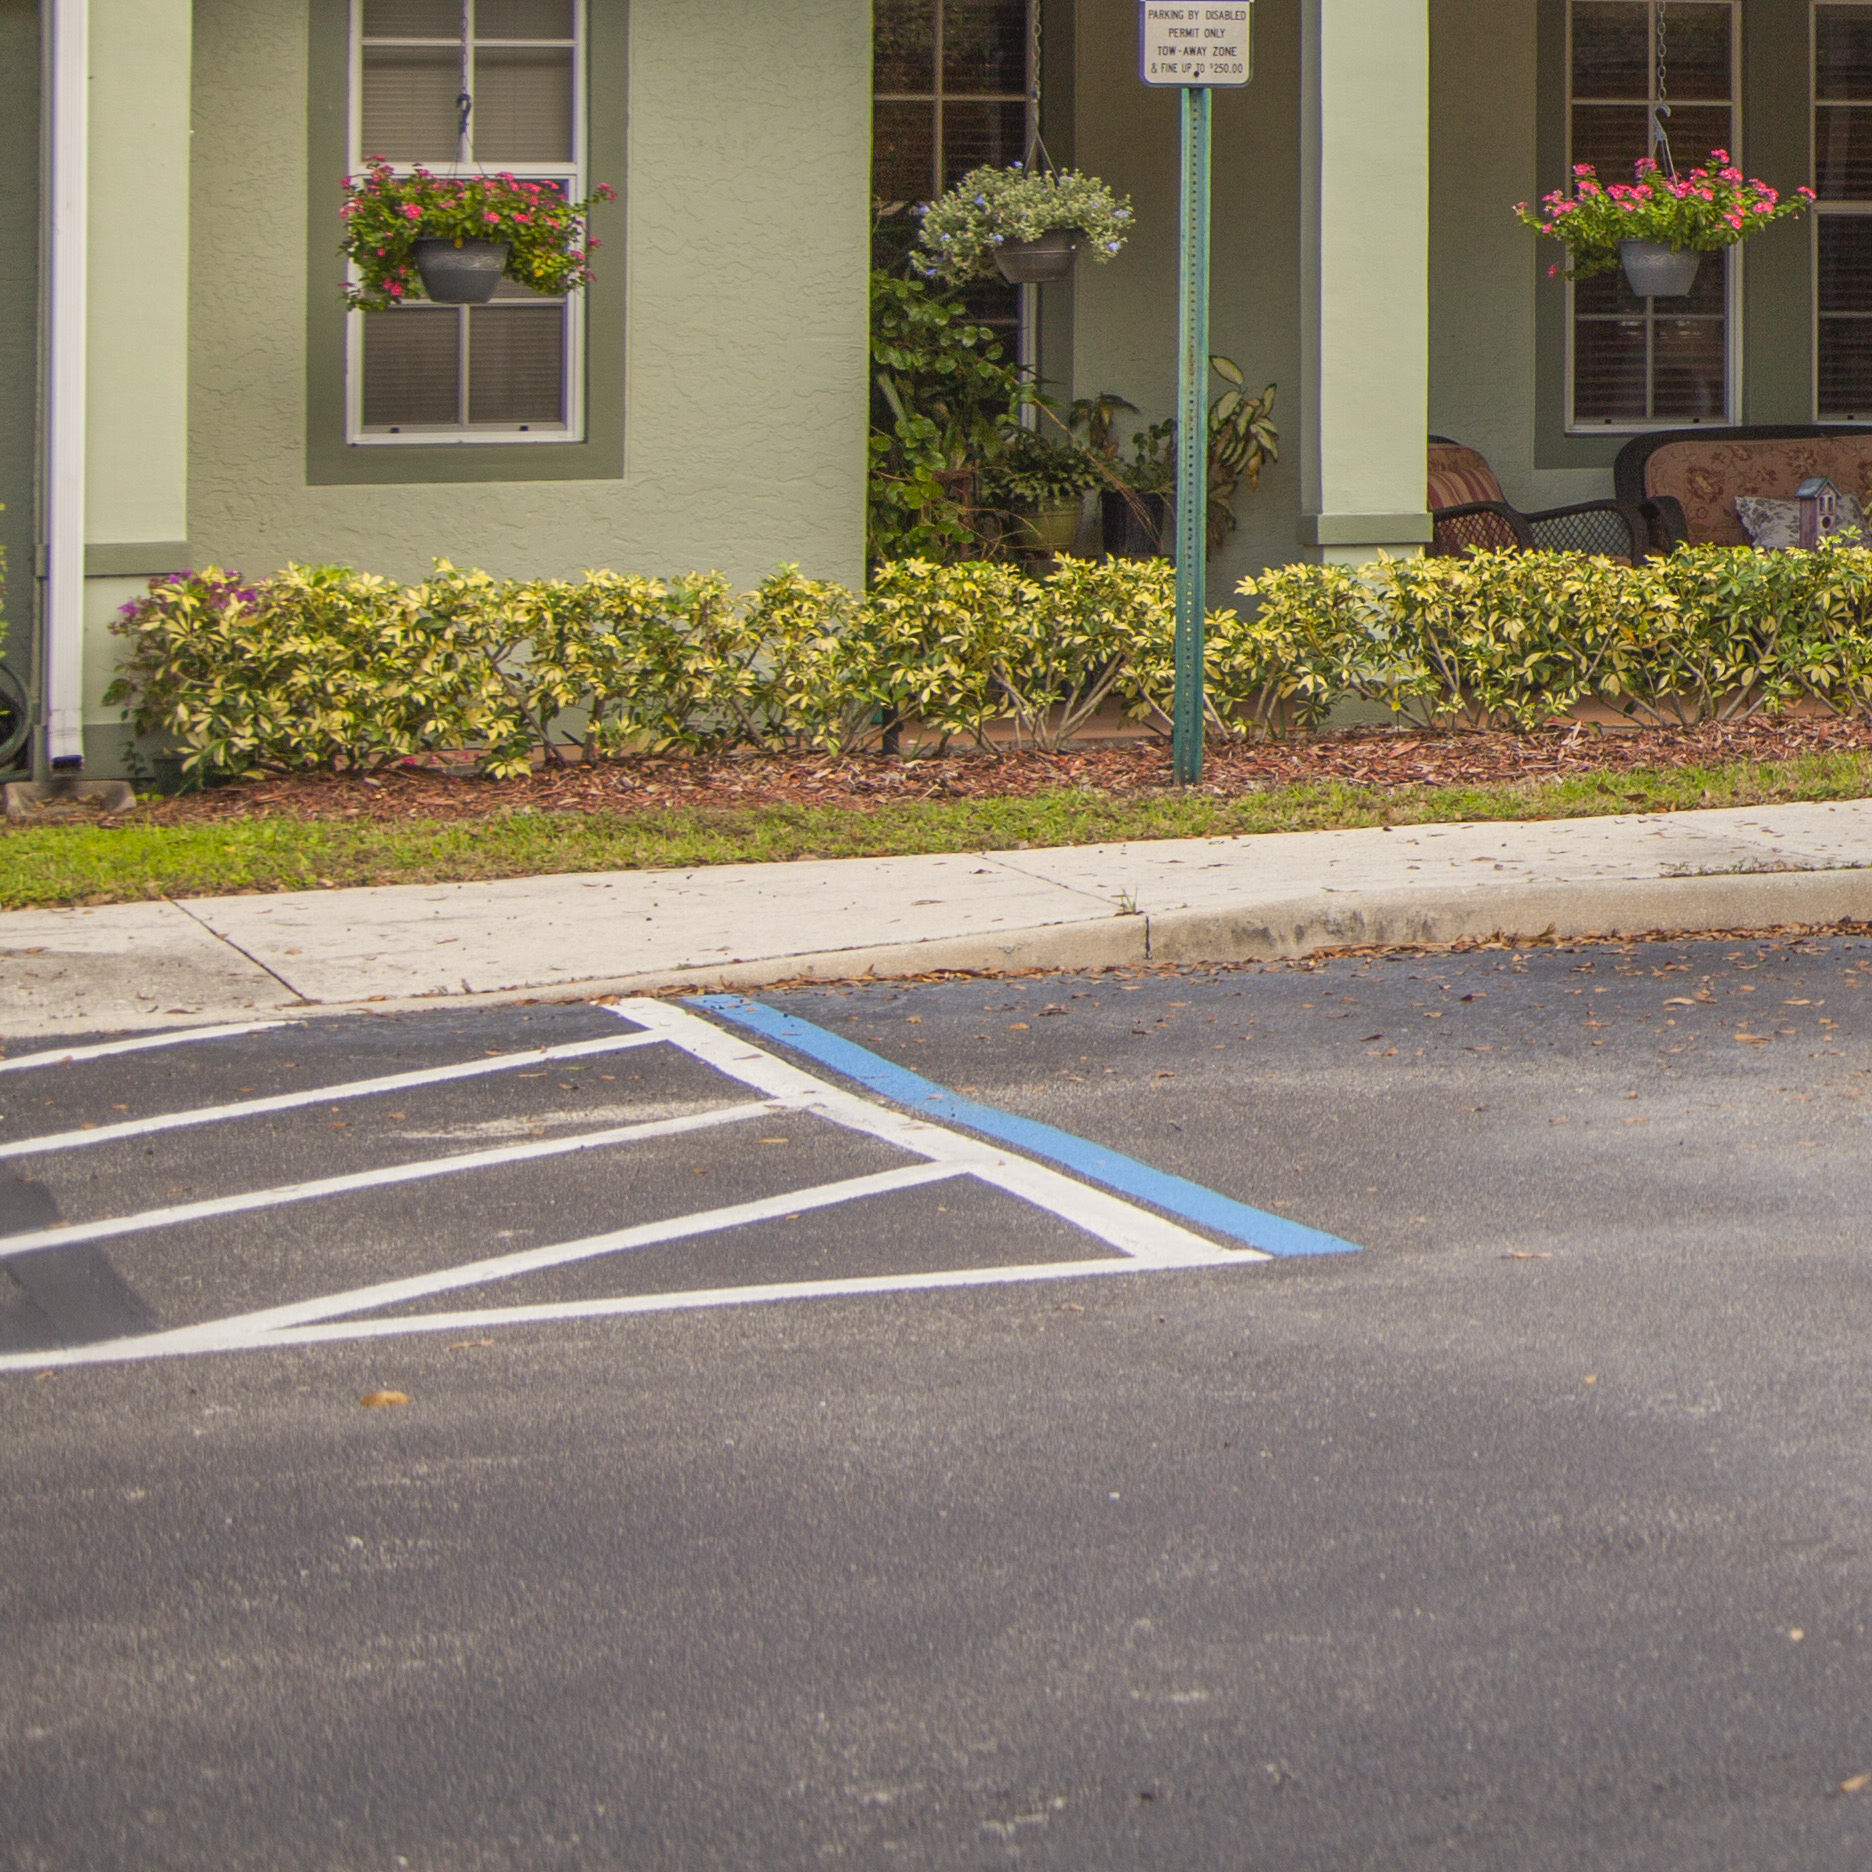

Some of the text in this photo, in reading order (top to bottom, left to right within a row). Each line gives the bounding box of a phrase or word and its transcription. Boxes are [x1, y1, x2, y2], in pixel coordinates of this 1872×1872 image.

[1148, 10, 1246, 20] PARKING BY DISABLED
[1168, 28, 1225, 38] PERMIT ONLY
[1212, 46, 1237, 56] ZONE
[1151, 63, 1243, 73] & FINE UP TO $250.00
